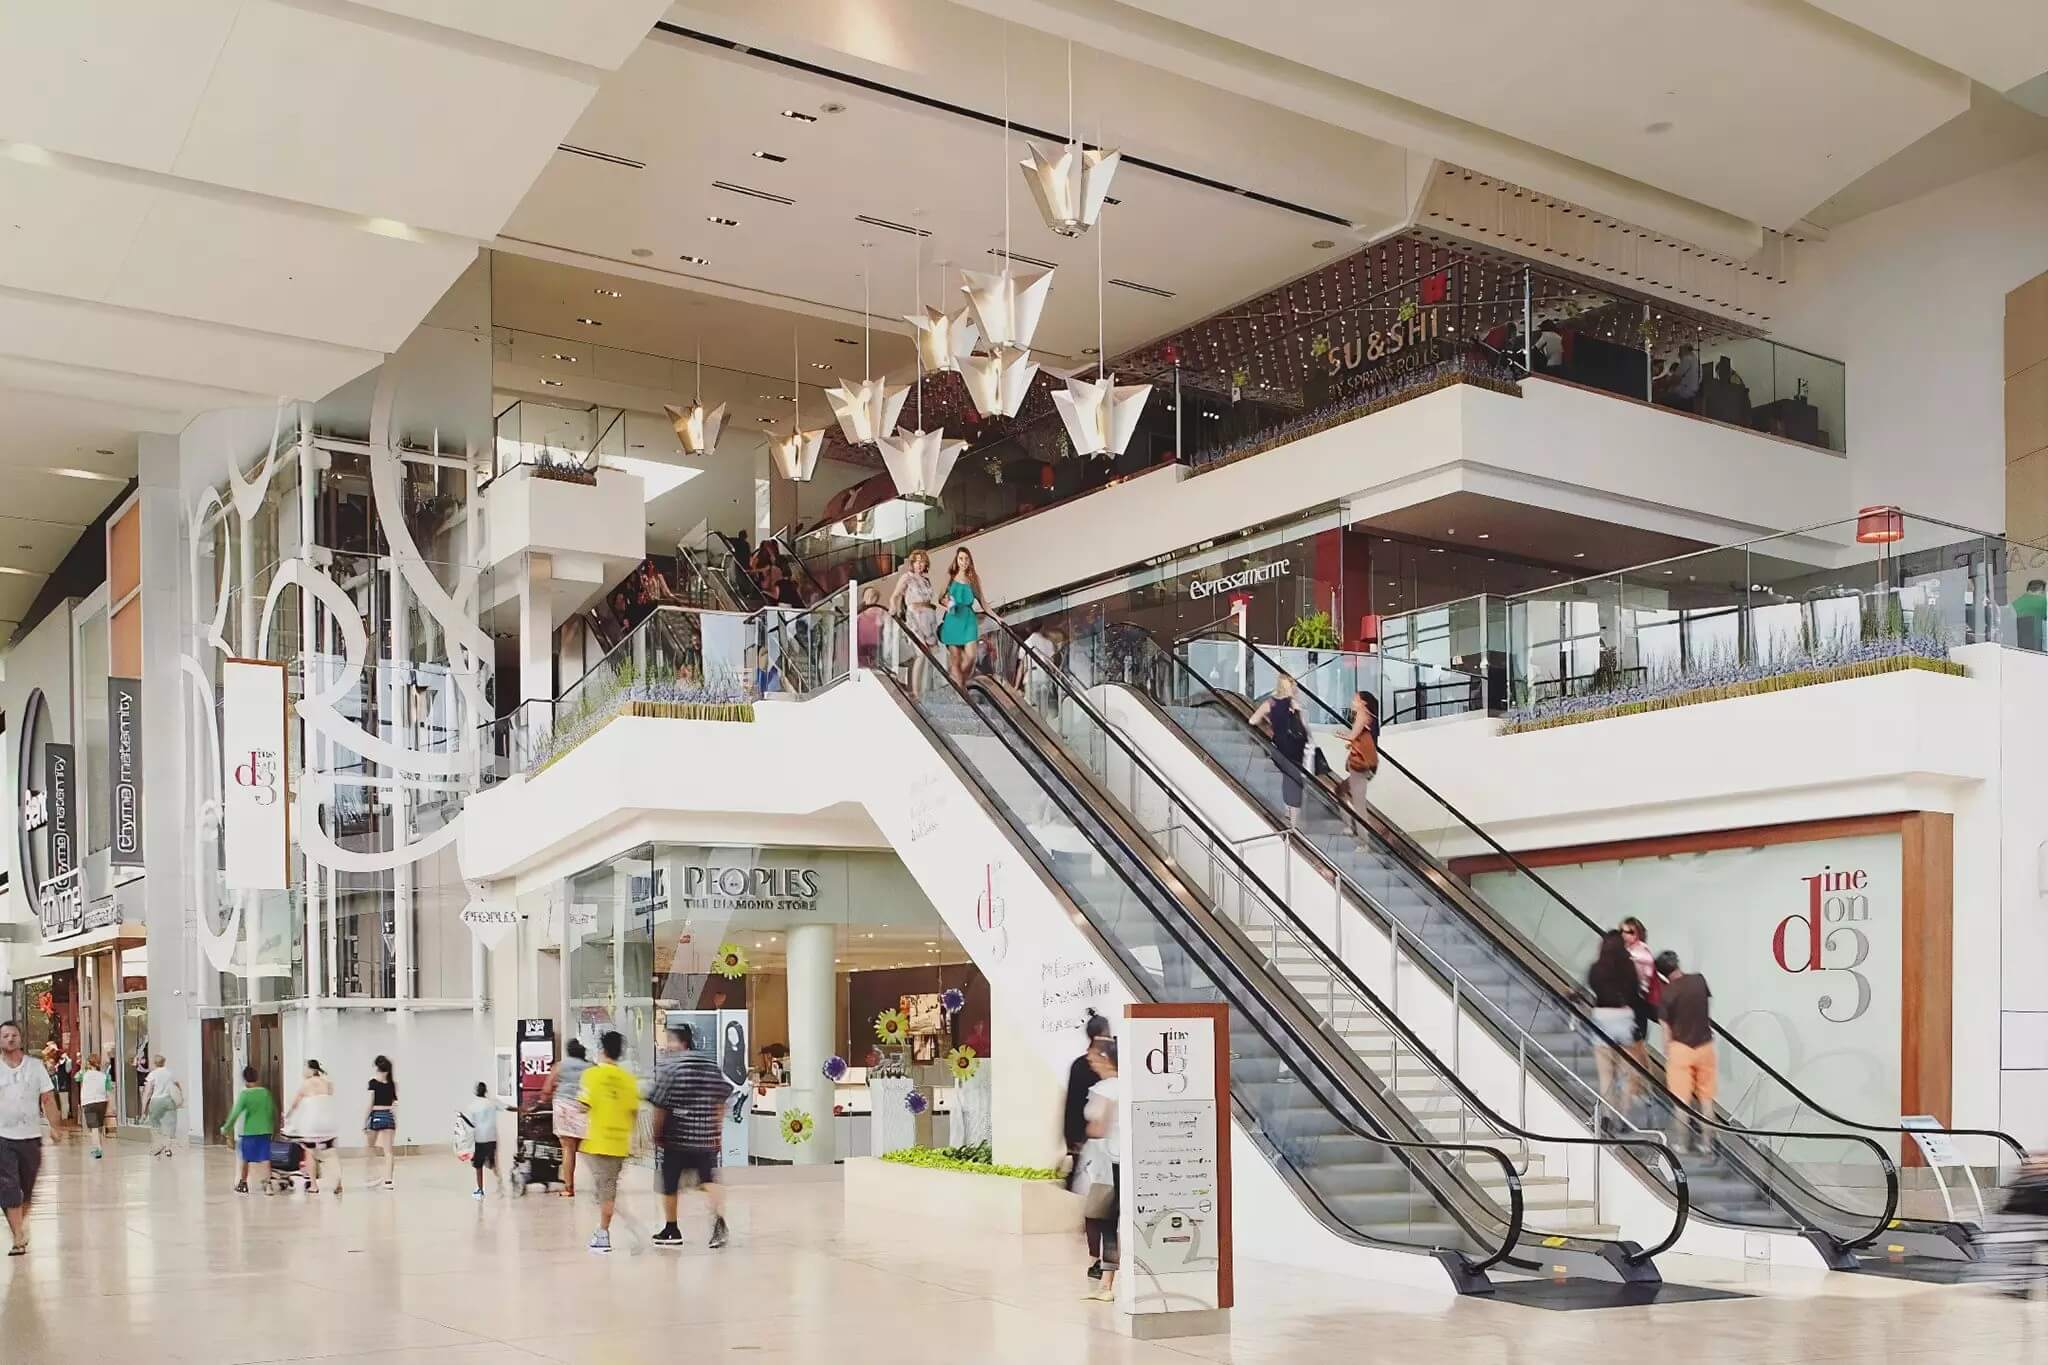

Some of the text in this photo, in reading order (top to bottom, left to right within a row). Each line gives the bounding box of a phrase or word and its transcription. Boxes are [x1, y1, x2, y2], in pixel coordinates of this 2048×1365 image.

[1328, 307, 1438, 377] SU&SHI
[684, 866, 820, 898] PEOPLES
[684, 899, 817, 911] THE DIAMOND STORE
[1824, 894, 1872, 922] on
[1818, 927, 1872, 1023] 3
[520, 1058, 553, 1077] SALE
